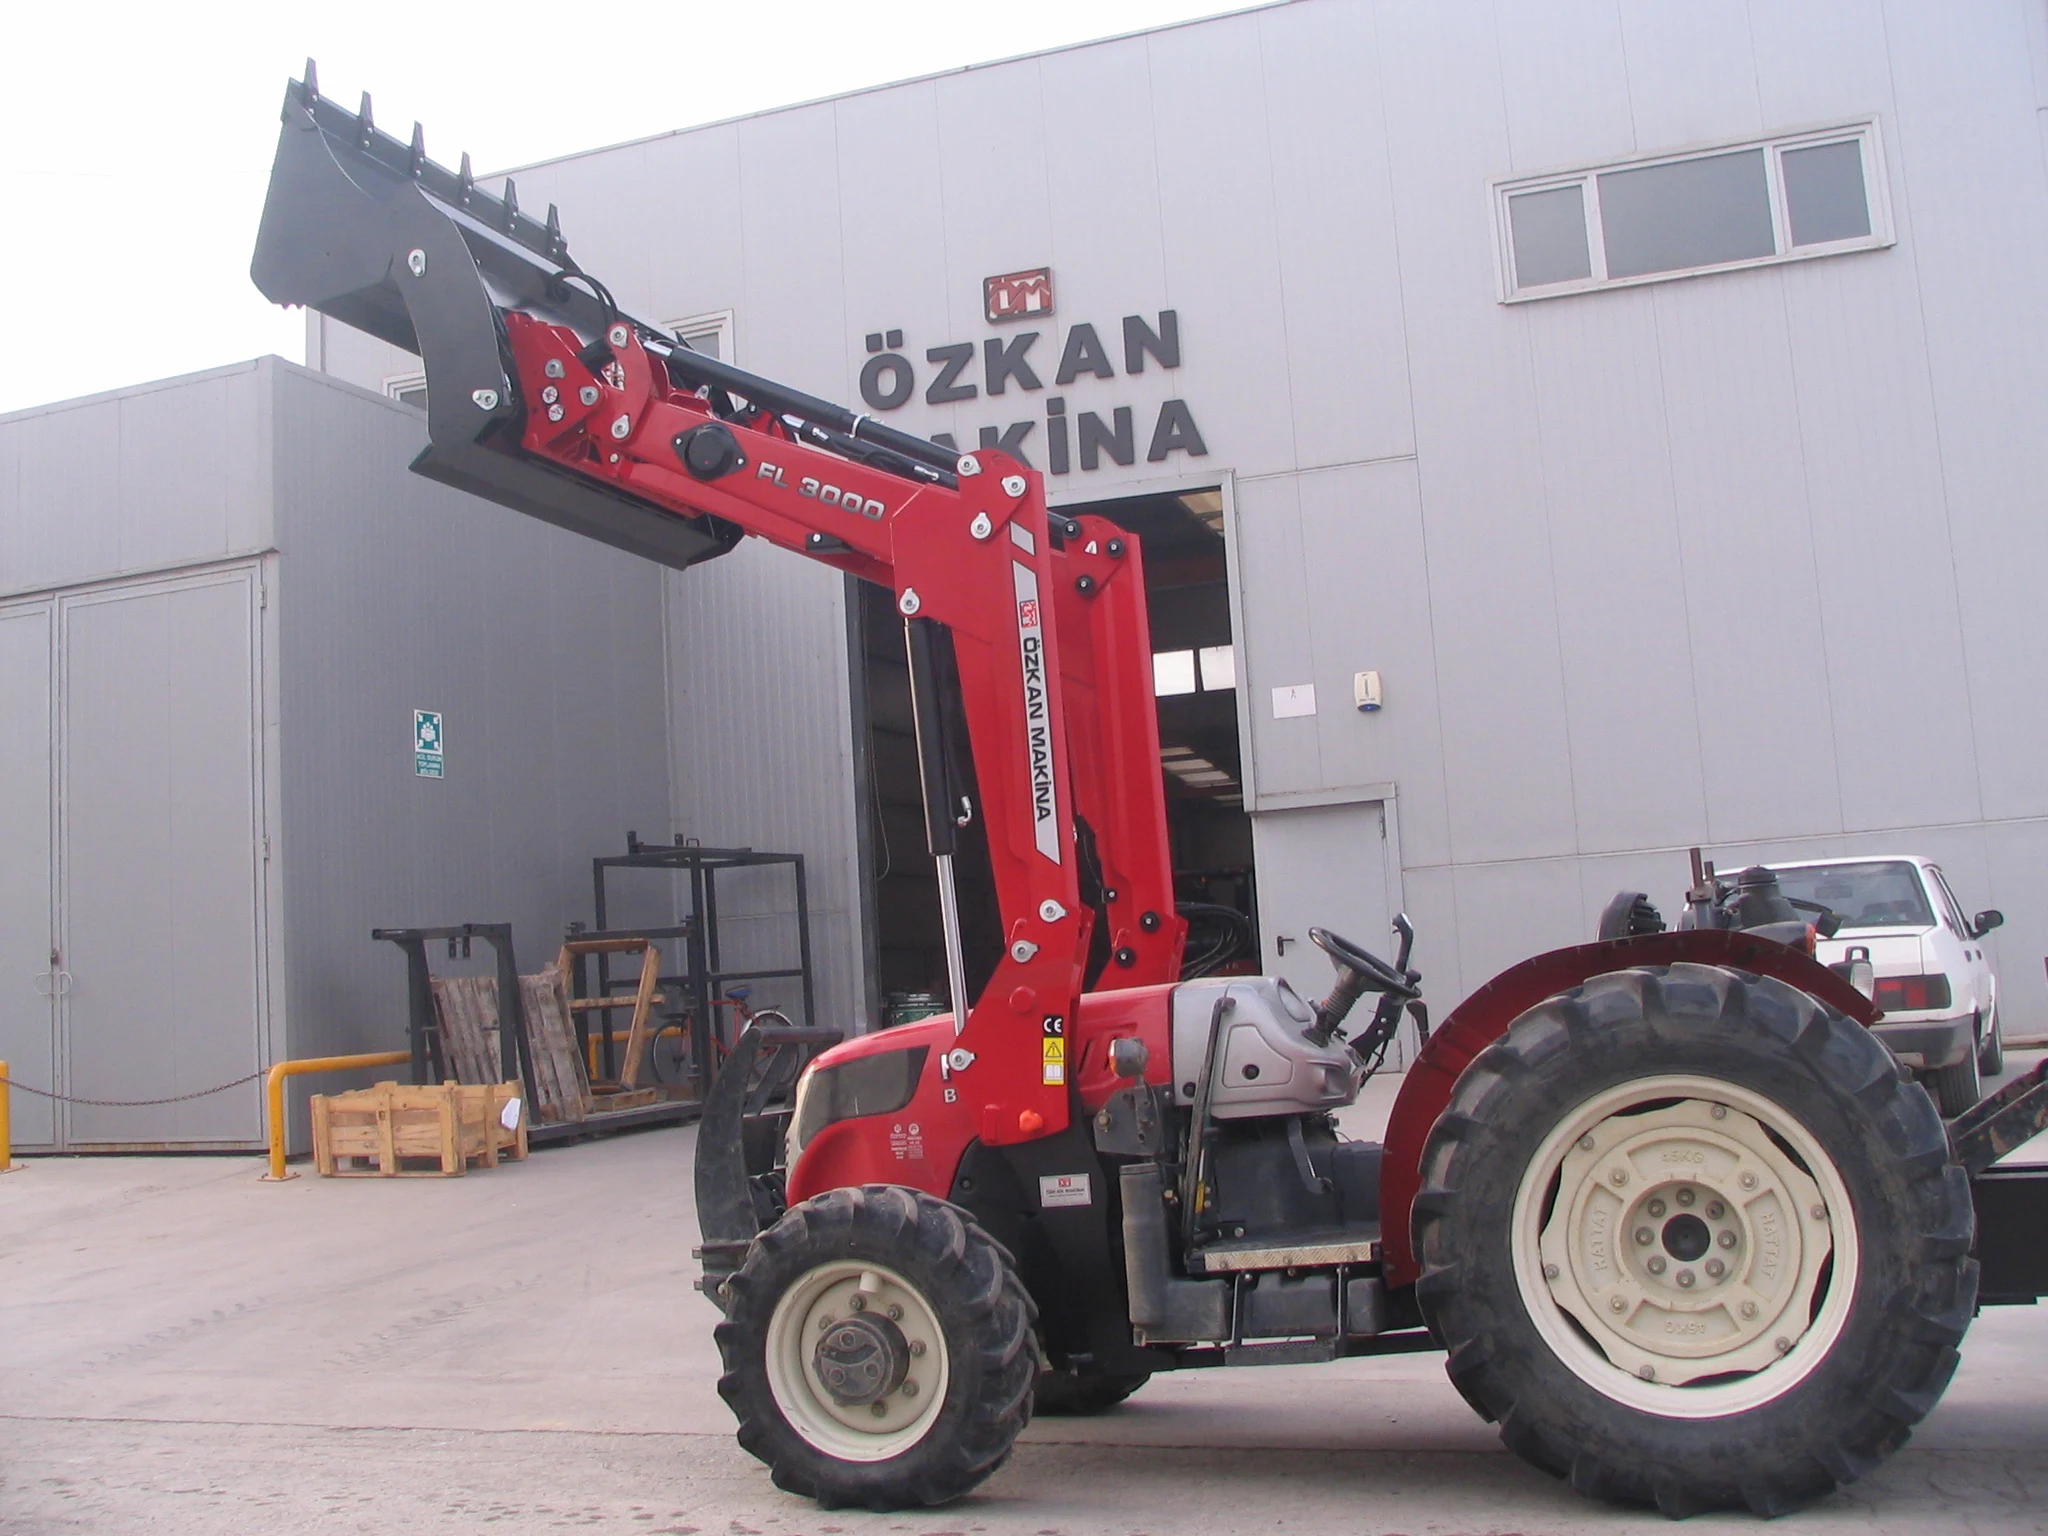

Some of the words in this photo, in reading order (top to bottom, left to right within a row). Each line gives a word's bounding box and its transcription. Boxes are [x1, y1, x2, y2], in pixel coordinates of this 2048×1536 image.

[859, 309, 1180, 411] ÖZKAN
[756, 461, 788, 489] FL
[799, 476, 885, 521] 3000
[1023, 637, 1043, 719] ÖZKAN
[1031, 727, 1051, 822] MAKİNA
[1043, 1017, 1062, 1033] CE
